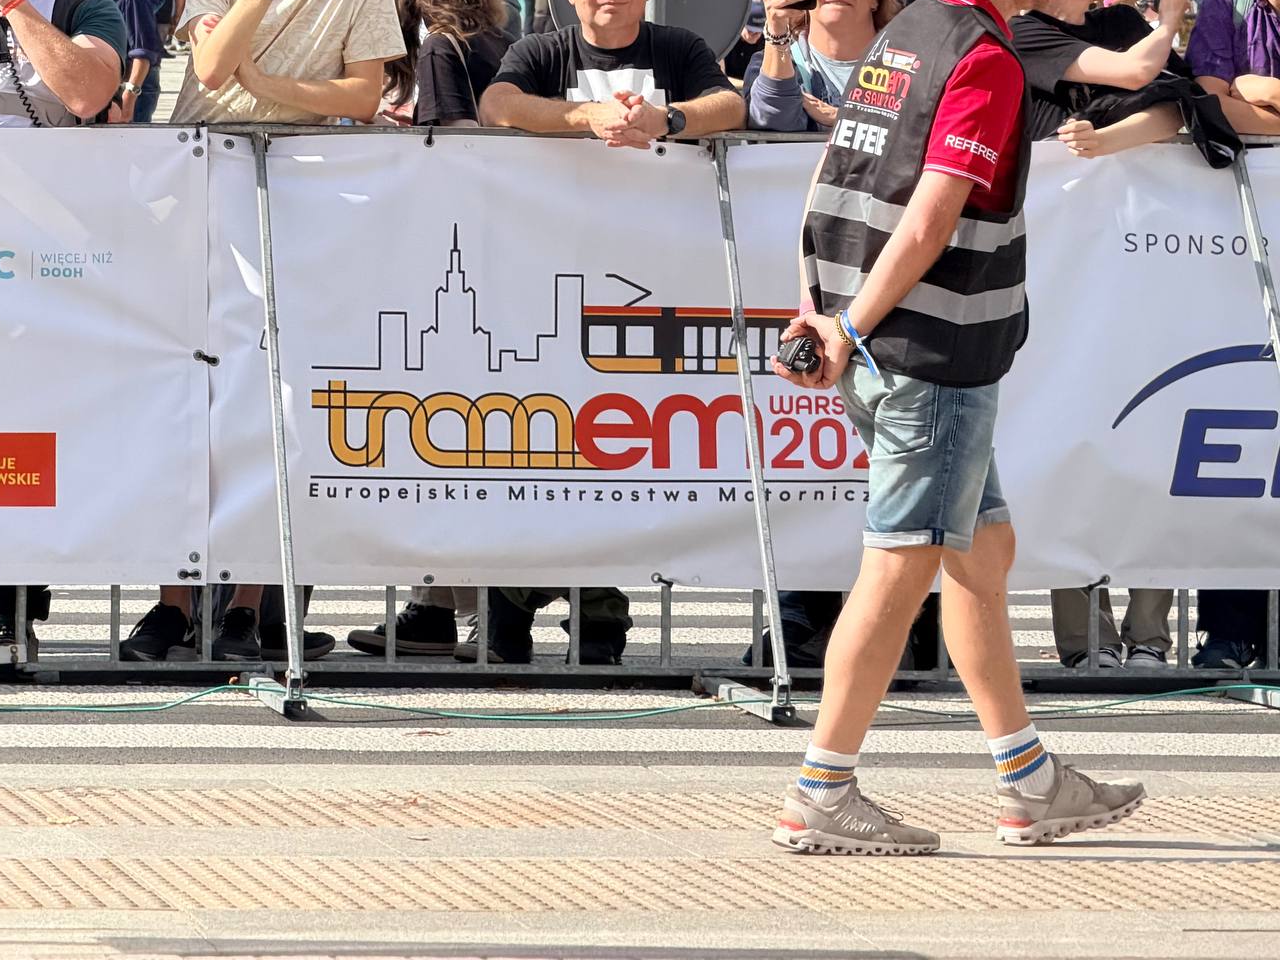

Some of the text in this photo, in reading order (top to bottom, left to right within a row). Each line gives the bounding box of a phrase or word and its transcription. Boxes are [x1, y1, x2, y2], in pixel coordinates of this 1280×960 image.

[944, 134, 999, 165] REFEREE
[40, 250, 113, 267] WIĘCEJ NIŻ
[40, 267, 83, 278] DOOH
[769, 394, 846, 416] WARS
[770, 417, 871, 470] 20
[1169, 408, 1280, 499] E
[308, 483, 871, 504] Europejskie Mistrzostwa Motornicz
